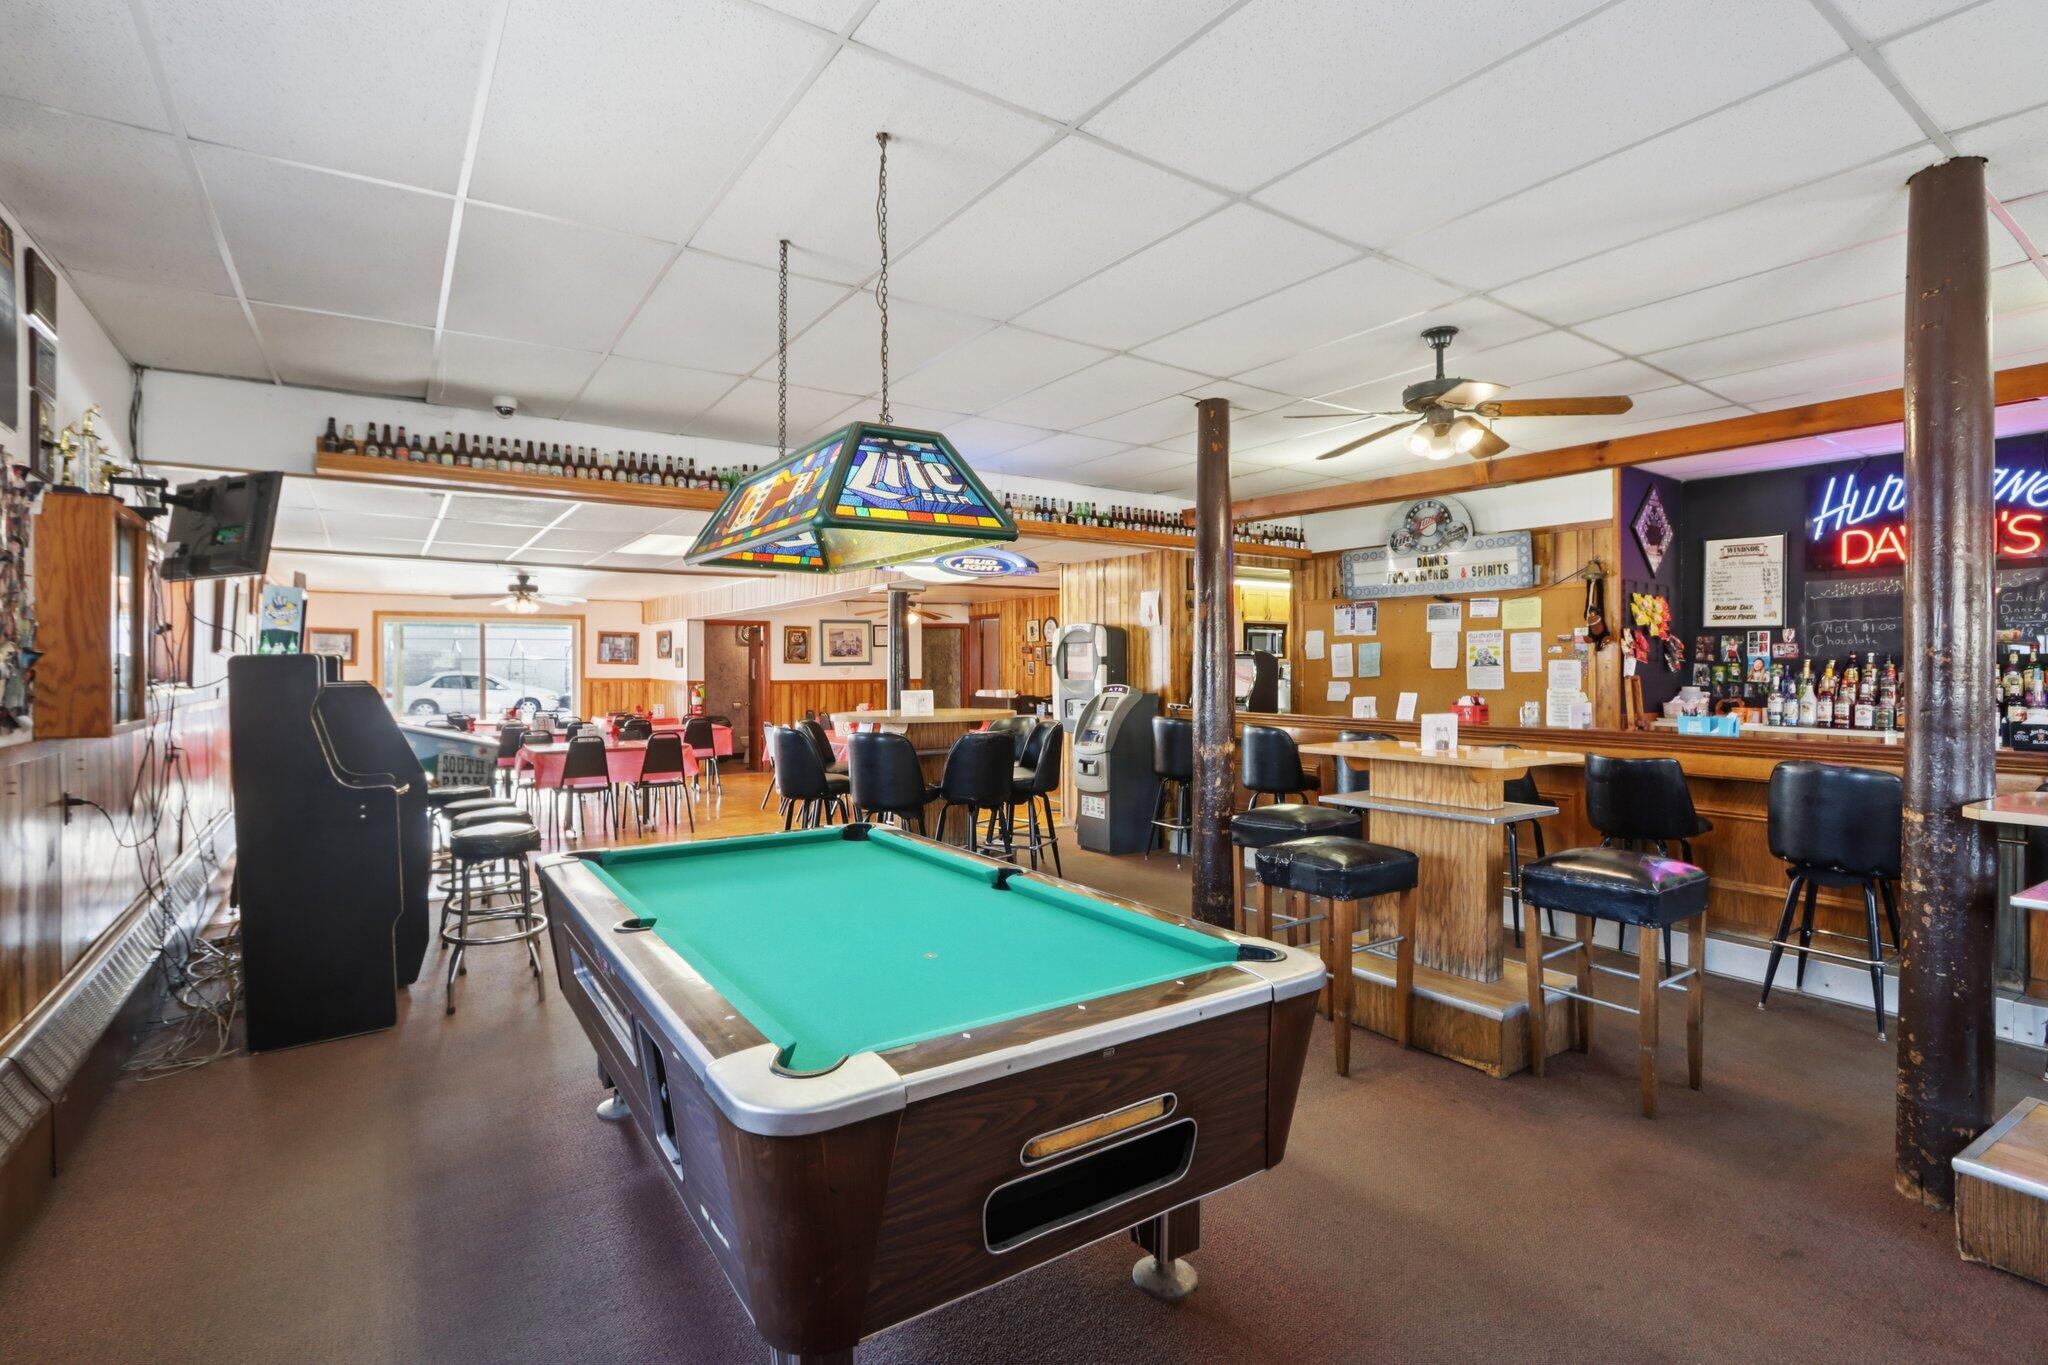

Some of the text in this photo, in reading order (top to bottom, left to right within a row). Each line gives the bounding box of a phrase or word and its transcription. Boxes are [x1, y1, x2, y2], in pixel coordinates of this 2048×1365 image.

[846, 451, 967, 500] Lite
[921, 492, 973, 505] BEER
[1842, 510, 2043, 565] DA'S
[954, 564, 1003, 572] LIGHT
[962, 558, 998, 566] BUD
[1417, 555, 1448, 568] DAWN'S
[1460, 567, 1467, 579] &
[1471, 563, 1509, 577] SPIRITS
[1822, 622, 1851, 633] Hot
[1812, 634, 1878, 649] Chocolate
[443, 755, 485, 774] SOUTH
